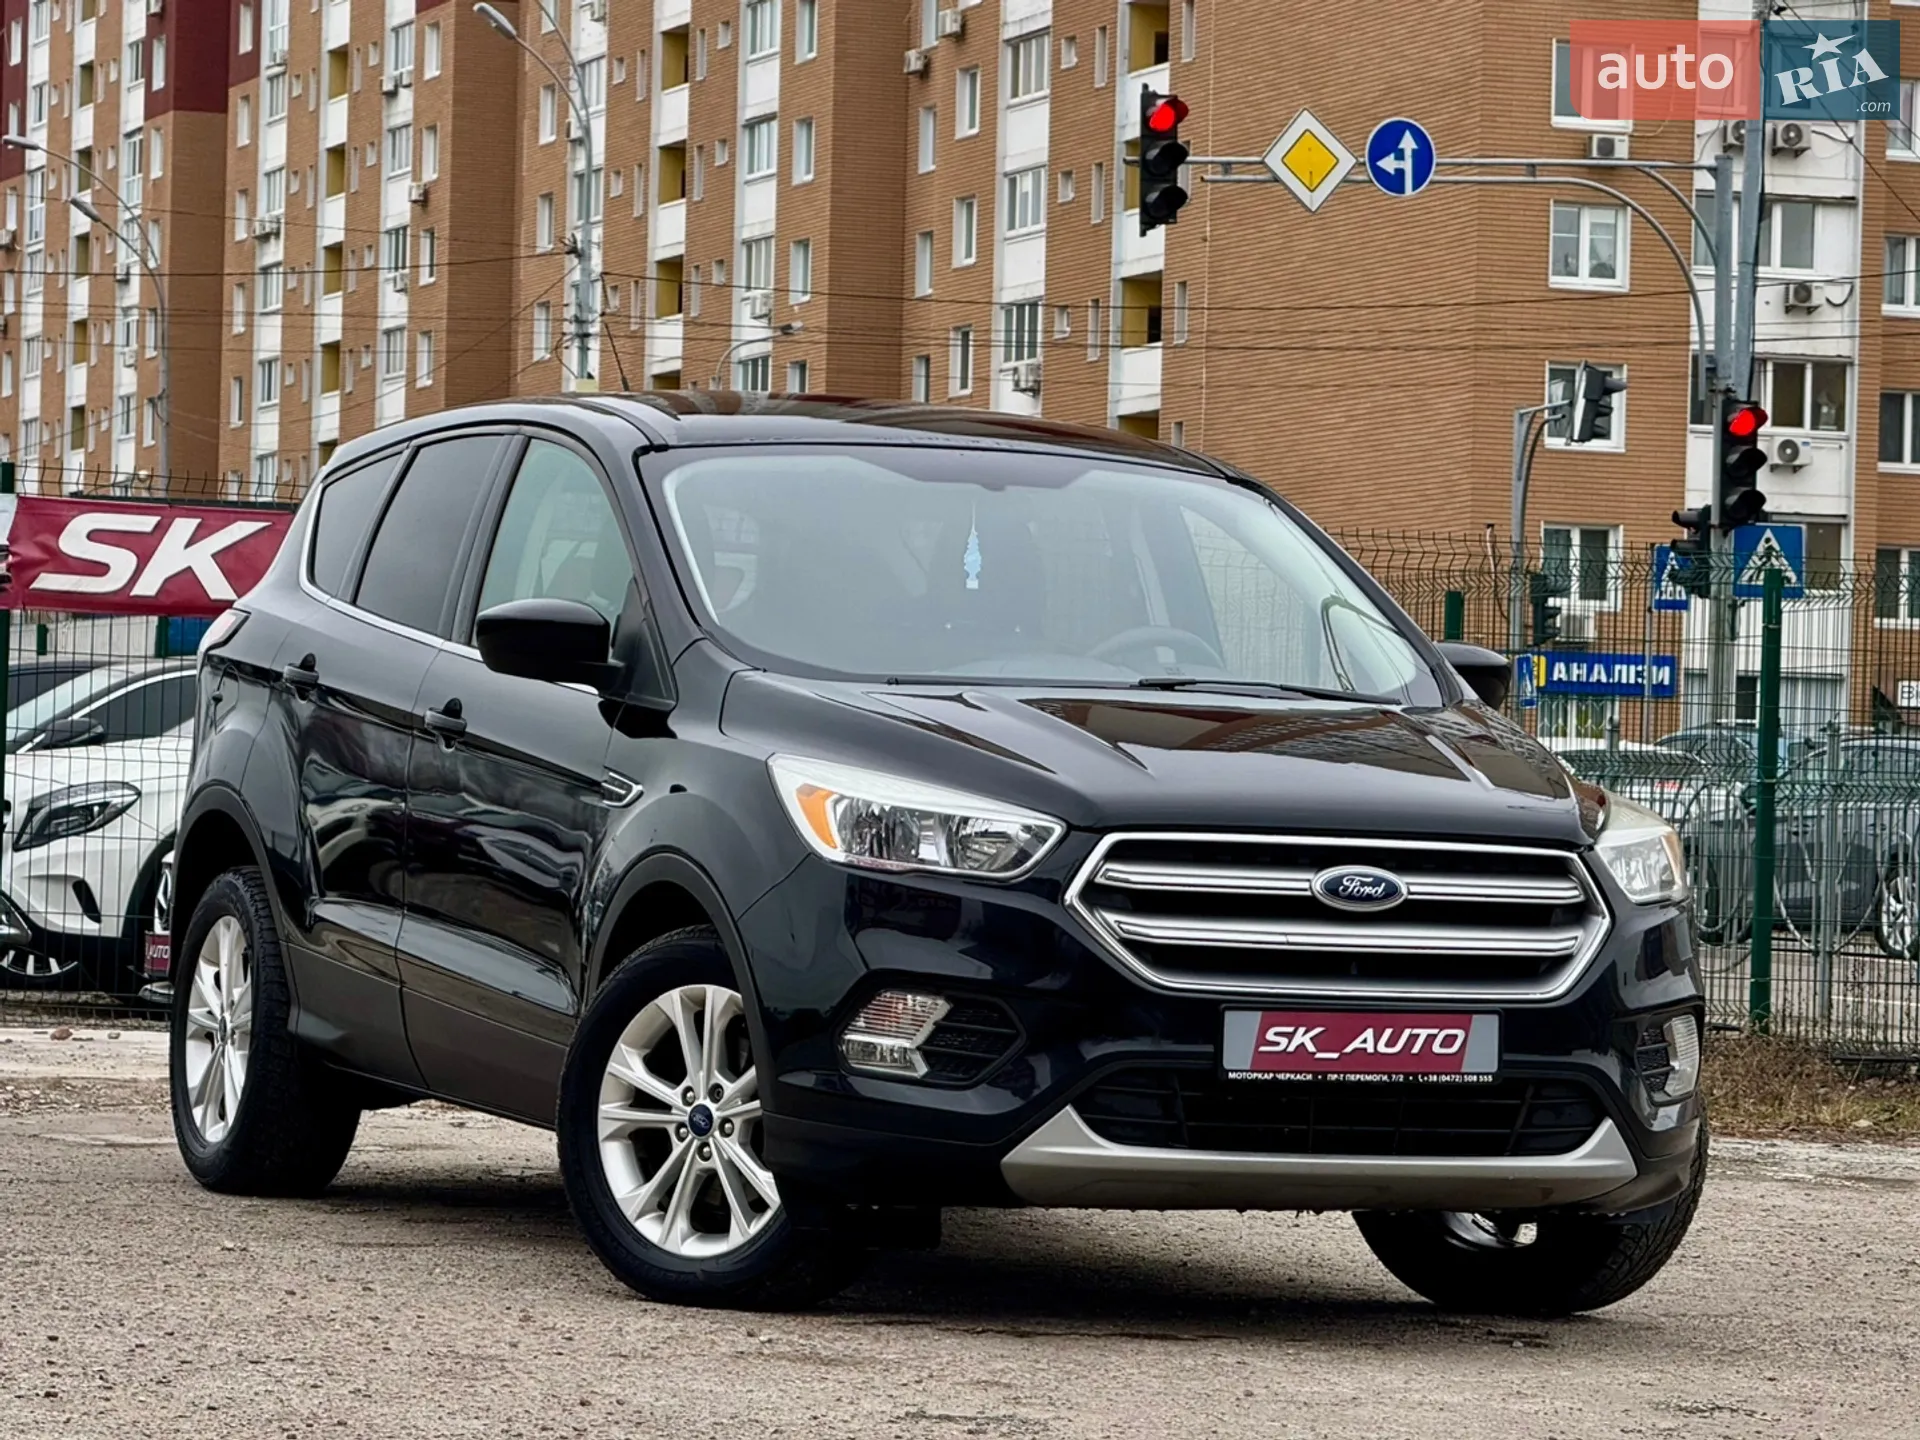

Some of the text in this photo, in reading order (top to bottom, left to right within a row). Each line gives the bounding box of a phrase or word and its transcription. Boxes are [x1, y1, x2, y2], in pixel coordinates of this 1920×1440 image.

[30, 512, 272, 600] SK
[1552, 661, 1671, 686] АНАЛІЗИ
[1339, 875, 1385, 897] Ford
[1258, 1026, 1466, 1059] SK_AUTO
[1228, 1071, 1274, 1080] МОТОРКАР
[1275, 1072, 1313, 1081] ЧЕРКАСИ
